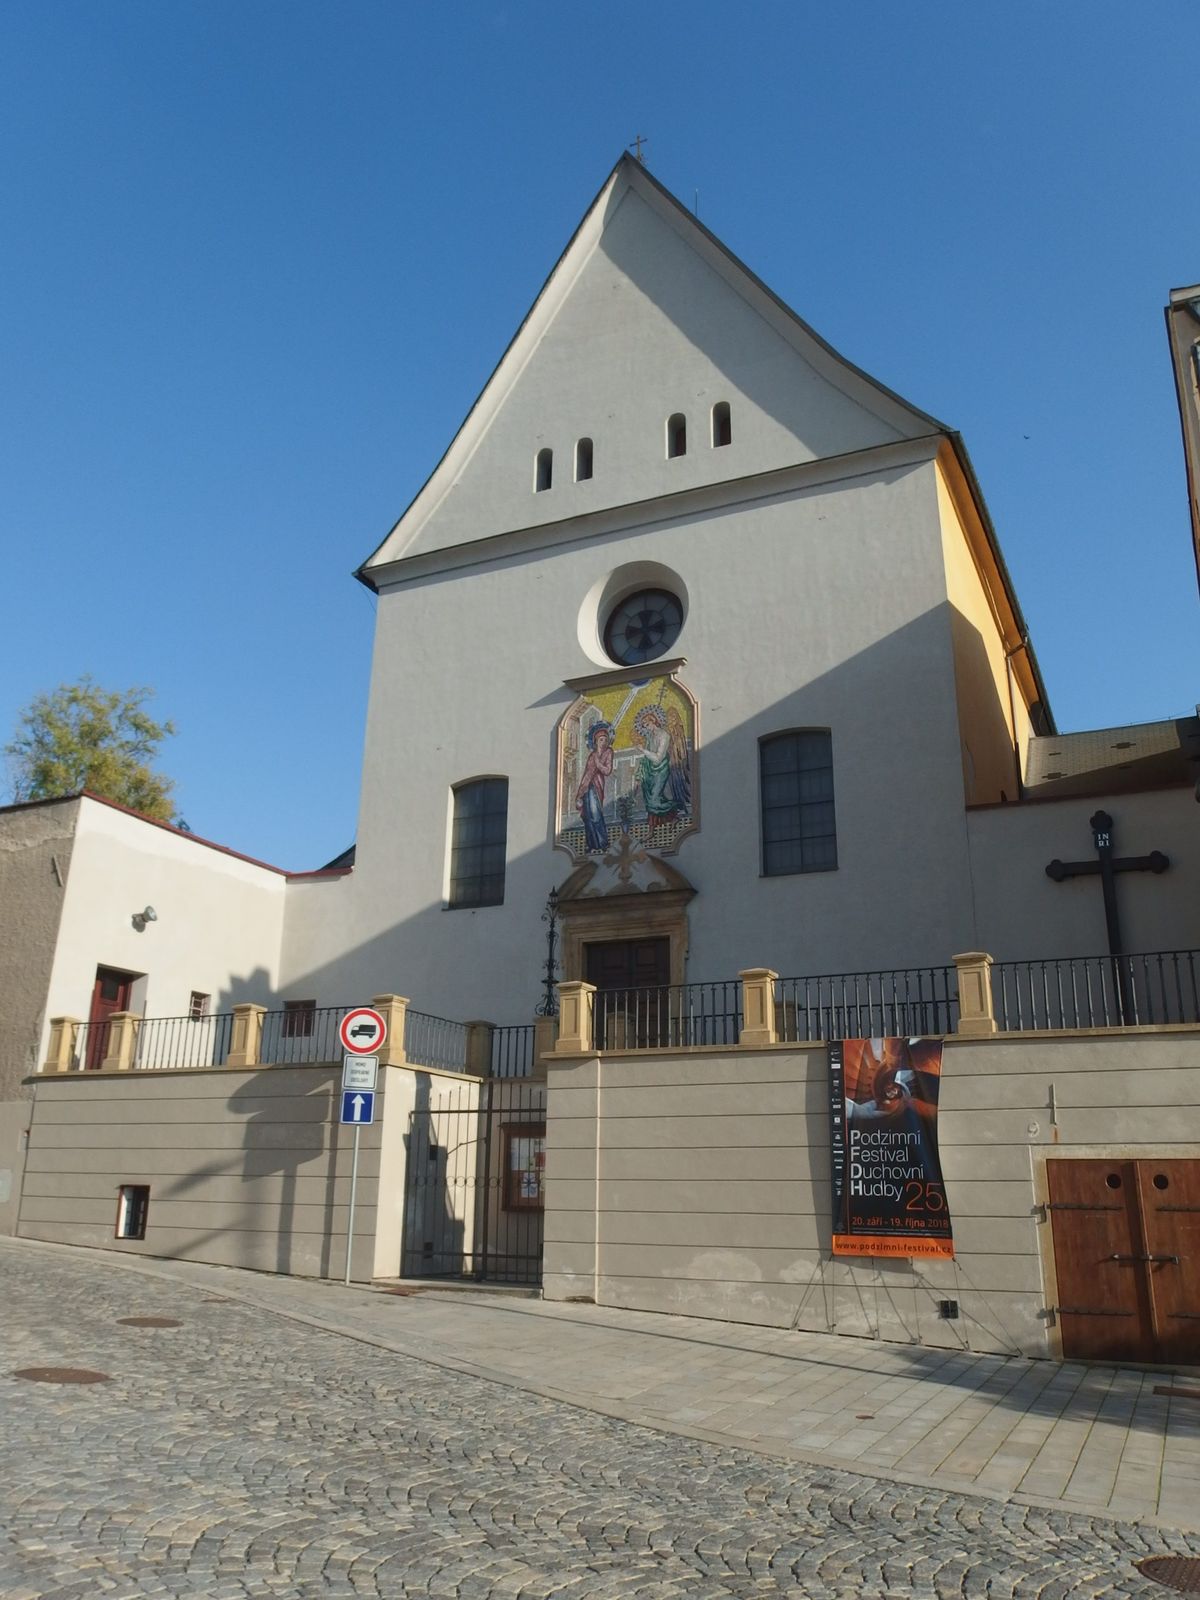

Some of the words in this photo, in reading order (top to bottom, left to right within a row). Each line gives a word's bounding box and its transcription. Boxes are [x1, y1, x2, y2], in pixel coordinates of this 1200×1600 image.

[1097, 832, 1109, 840] IN
[850, 1129, 921, 1146] Podzimní
[850, 1146, 909, 1162] Festival
[850, 1163, 924, 1180] Duchovní
[850, 1180, 904, 1202] Hudby
[905, 1181, 948, 1212] 25.
[852, 1217, 865, 1226] 20.
[866, 1216, 882, 1226] září
[890, 1217, 903, 1227] 19.
[905, 1217, 925, 1229] října
[927, 1218, 949, 1228] 2018
[836, 1242, 952, 1254] www.podzimni-festival.cz
